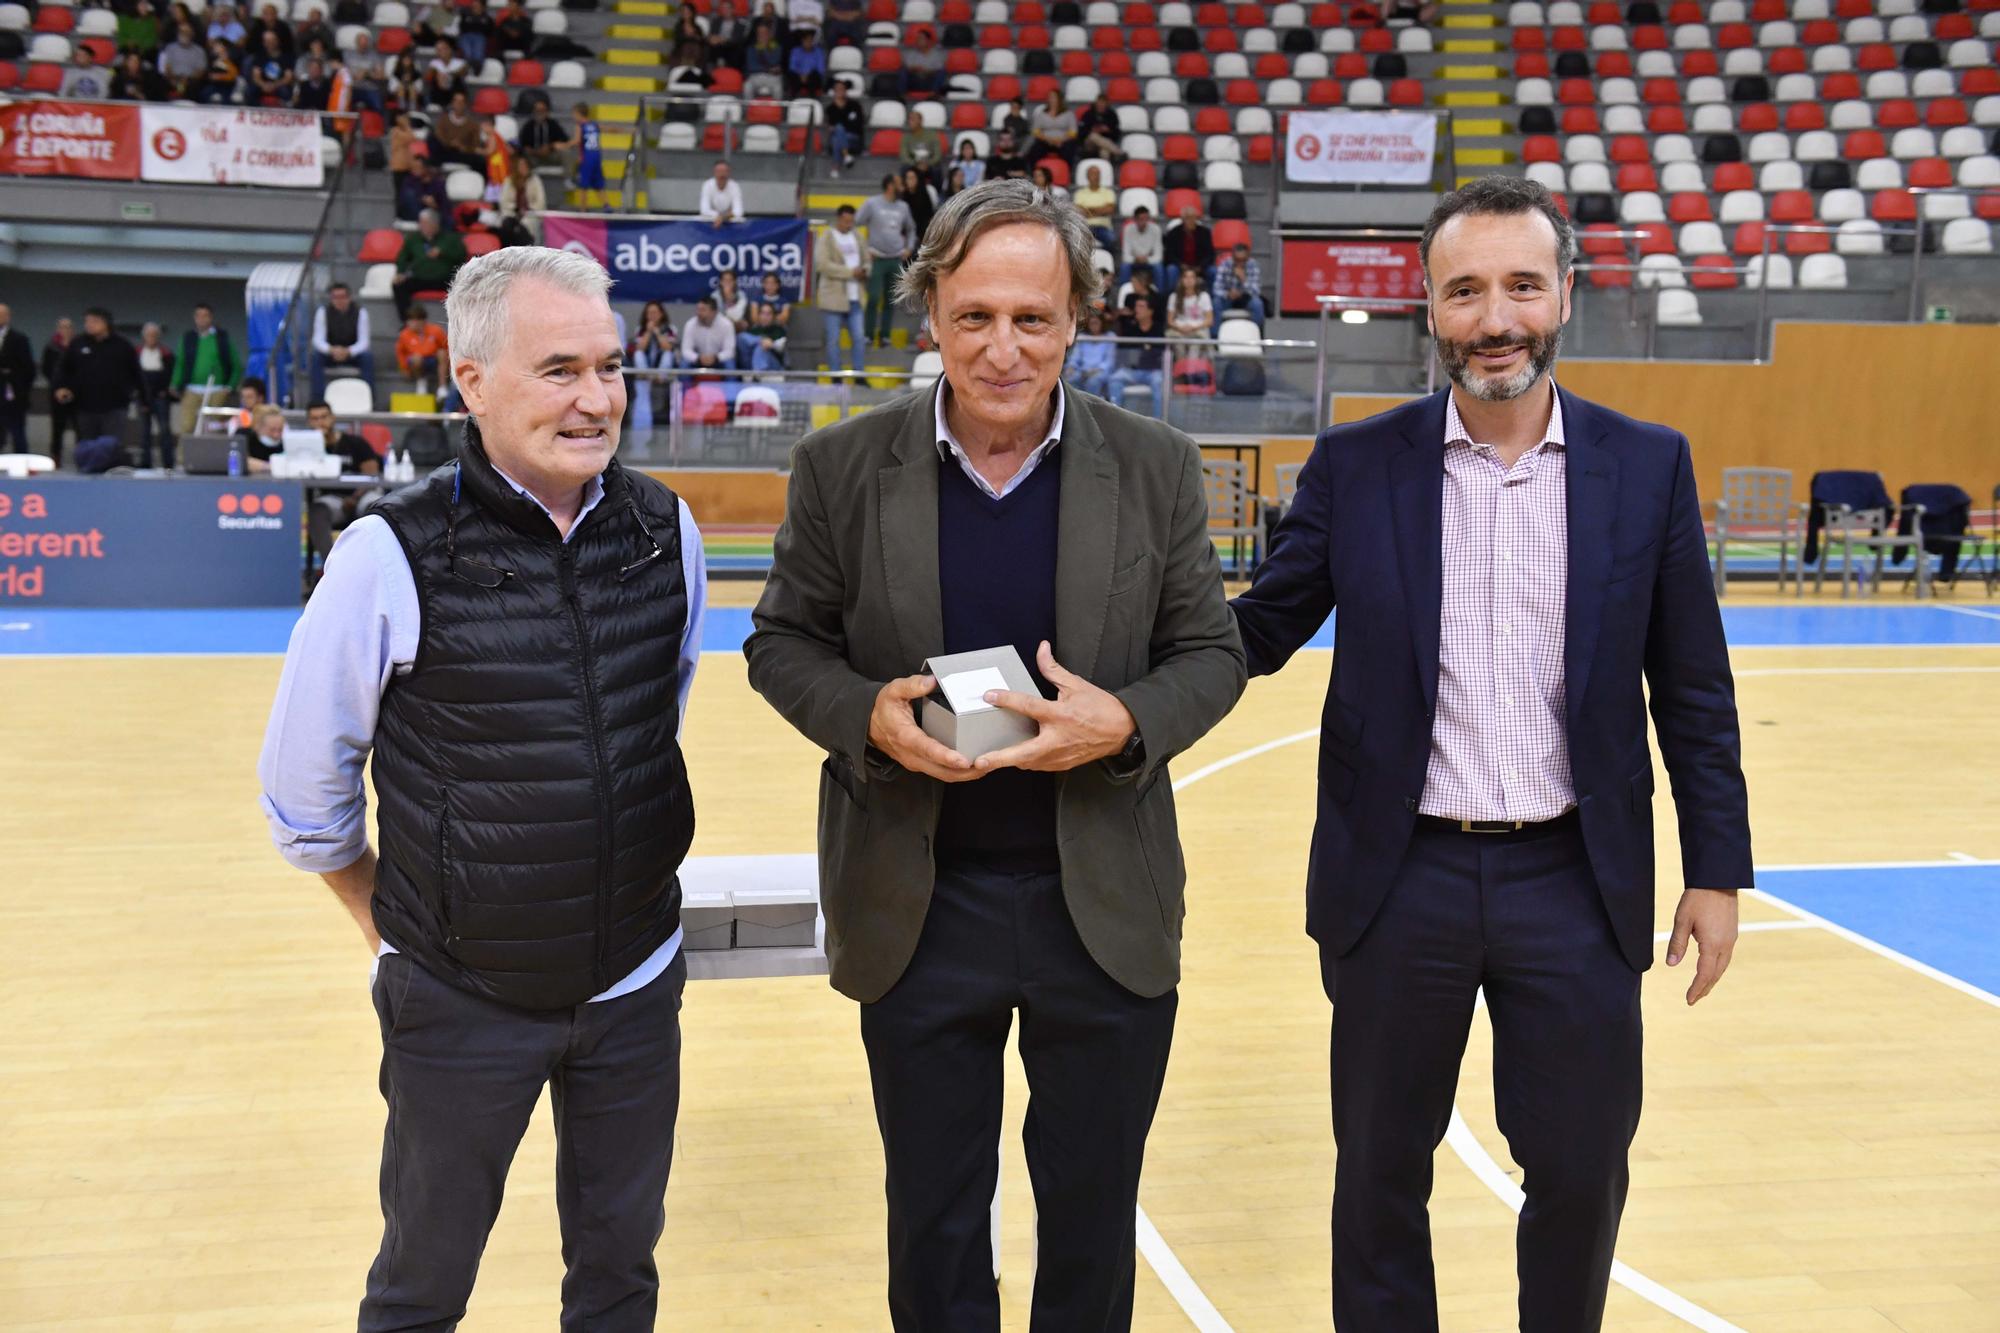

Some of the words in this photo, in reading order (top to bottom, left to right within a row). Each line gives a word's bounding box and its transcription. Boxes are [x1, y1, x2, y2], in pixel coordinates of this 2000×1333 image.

[30, 112, 105, 136] CORUÑA
[32, 136, 114, 160] DEPORTE
[247, 147, 315, 168] CORUÑA
[615, 234, 803, 272] abeconsa
[21, 493, 48, 518] a
[218, 515, 283, 530] Securitas
